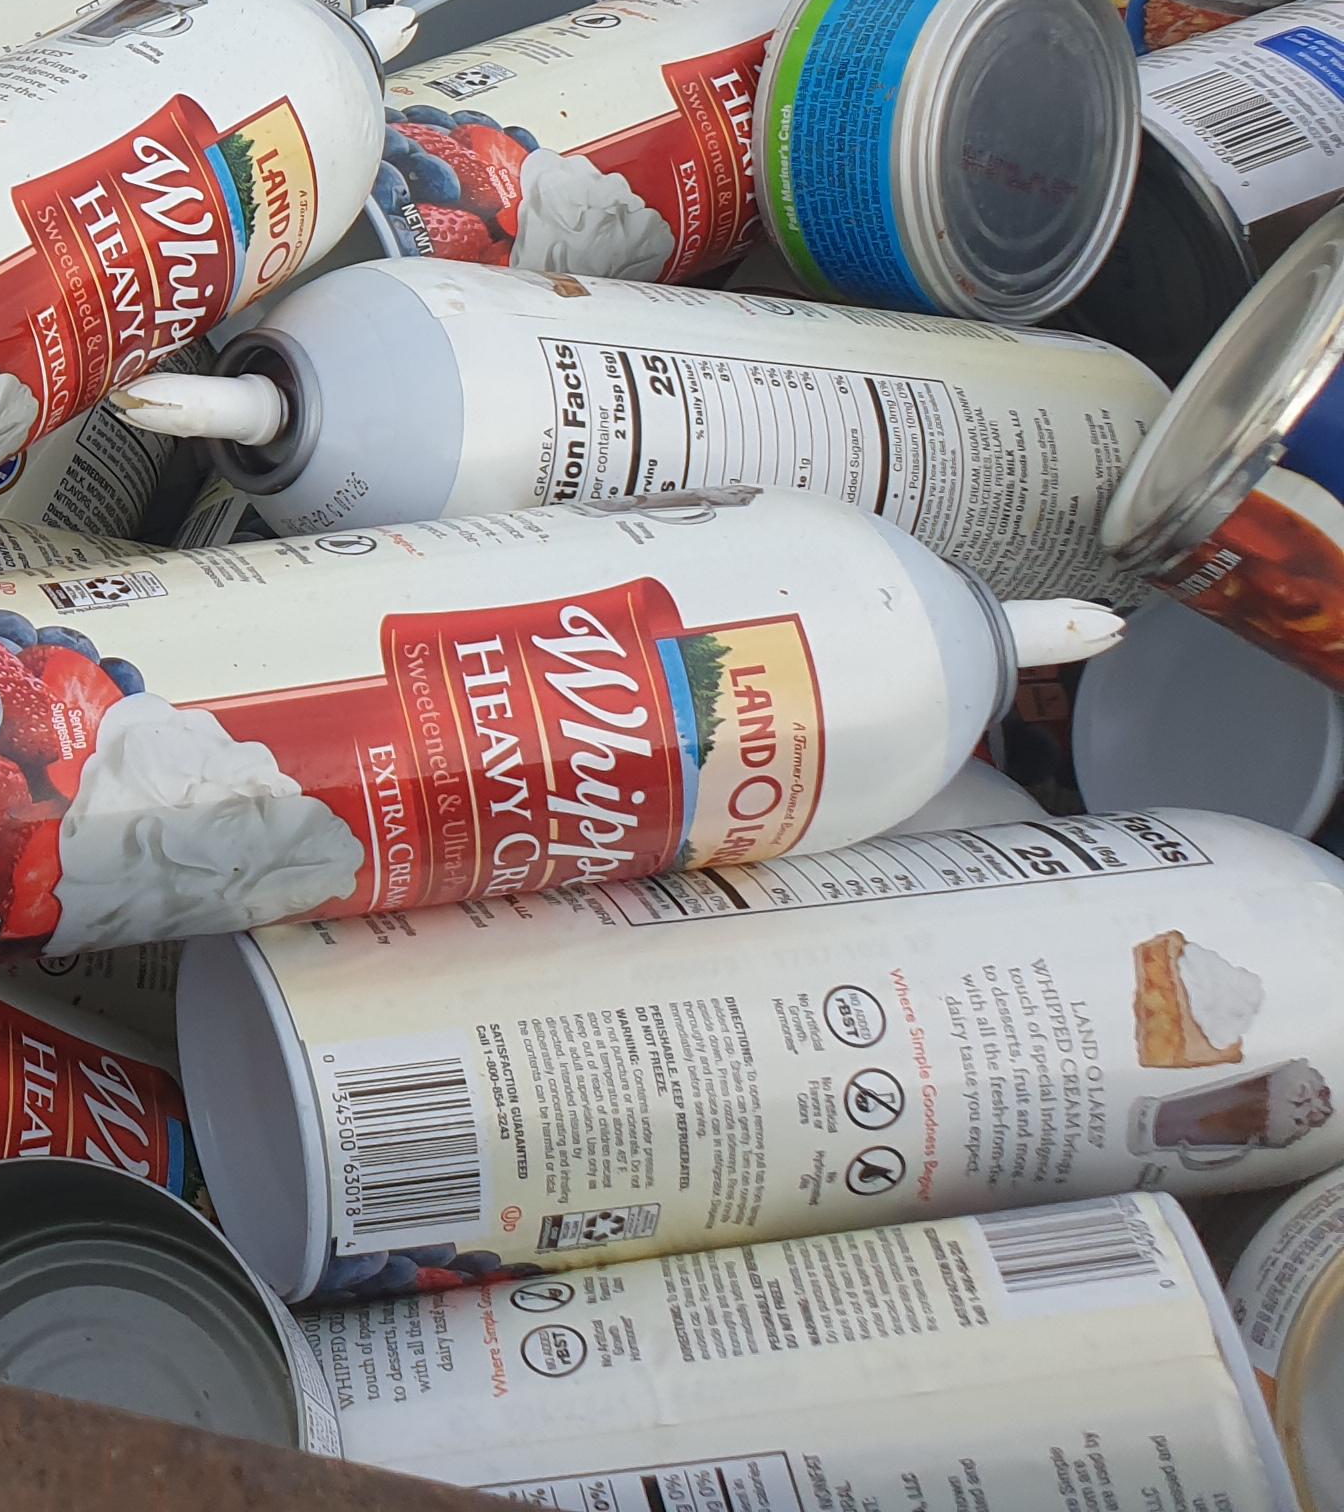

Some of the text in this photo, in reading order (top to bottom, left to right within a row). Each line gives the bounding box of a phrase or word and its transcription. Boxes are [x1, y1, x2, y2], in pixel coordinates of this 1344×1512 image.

[683, 82, 732, 186] Sweetened
[779, 105, 793, 201] Mariner's Catch
[255, 148, 290, 239] LAND
[679, 160, 701, 234] EXTRA
[37, 205, 101, 331] Sweetened
[70, 181, 145, 344] HEAVY
[37, 305, 69, 391] EXTRA
[555, 344, 586, 428] Facts
[642, 354, 676, 397] 25
[600, 351, 627, 439] 2 Tbsp (6g)
[534, 441, 552, 497] GRADE
[593, 406, 609, 480] container
[50, 703, 73, 760] Suggestion
[69, 709, 86, 749] Serving
[404, 642, 449, 787] Sweetened
[454, 634, 532, 820] HEAVY
[727, 665, 778, 768] LAND
[368, 742, 408, 840] EXTRA
[476, 1026, 488, 1045] Call
[490, 1024, 528, 1179] SATISFACTION GUARANTEED
[332, 1092, 361, 1217] 34500 63018
